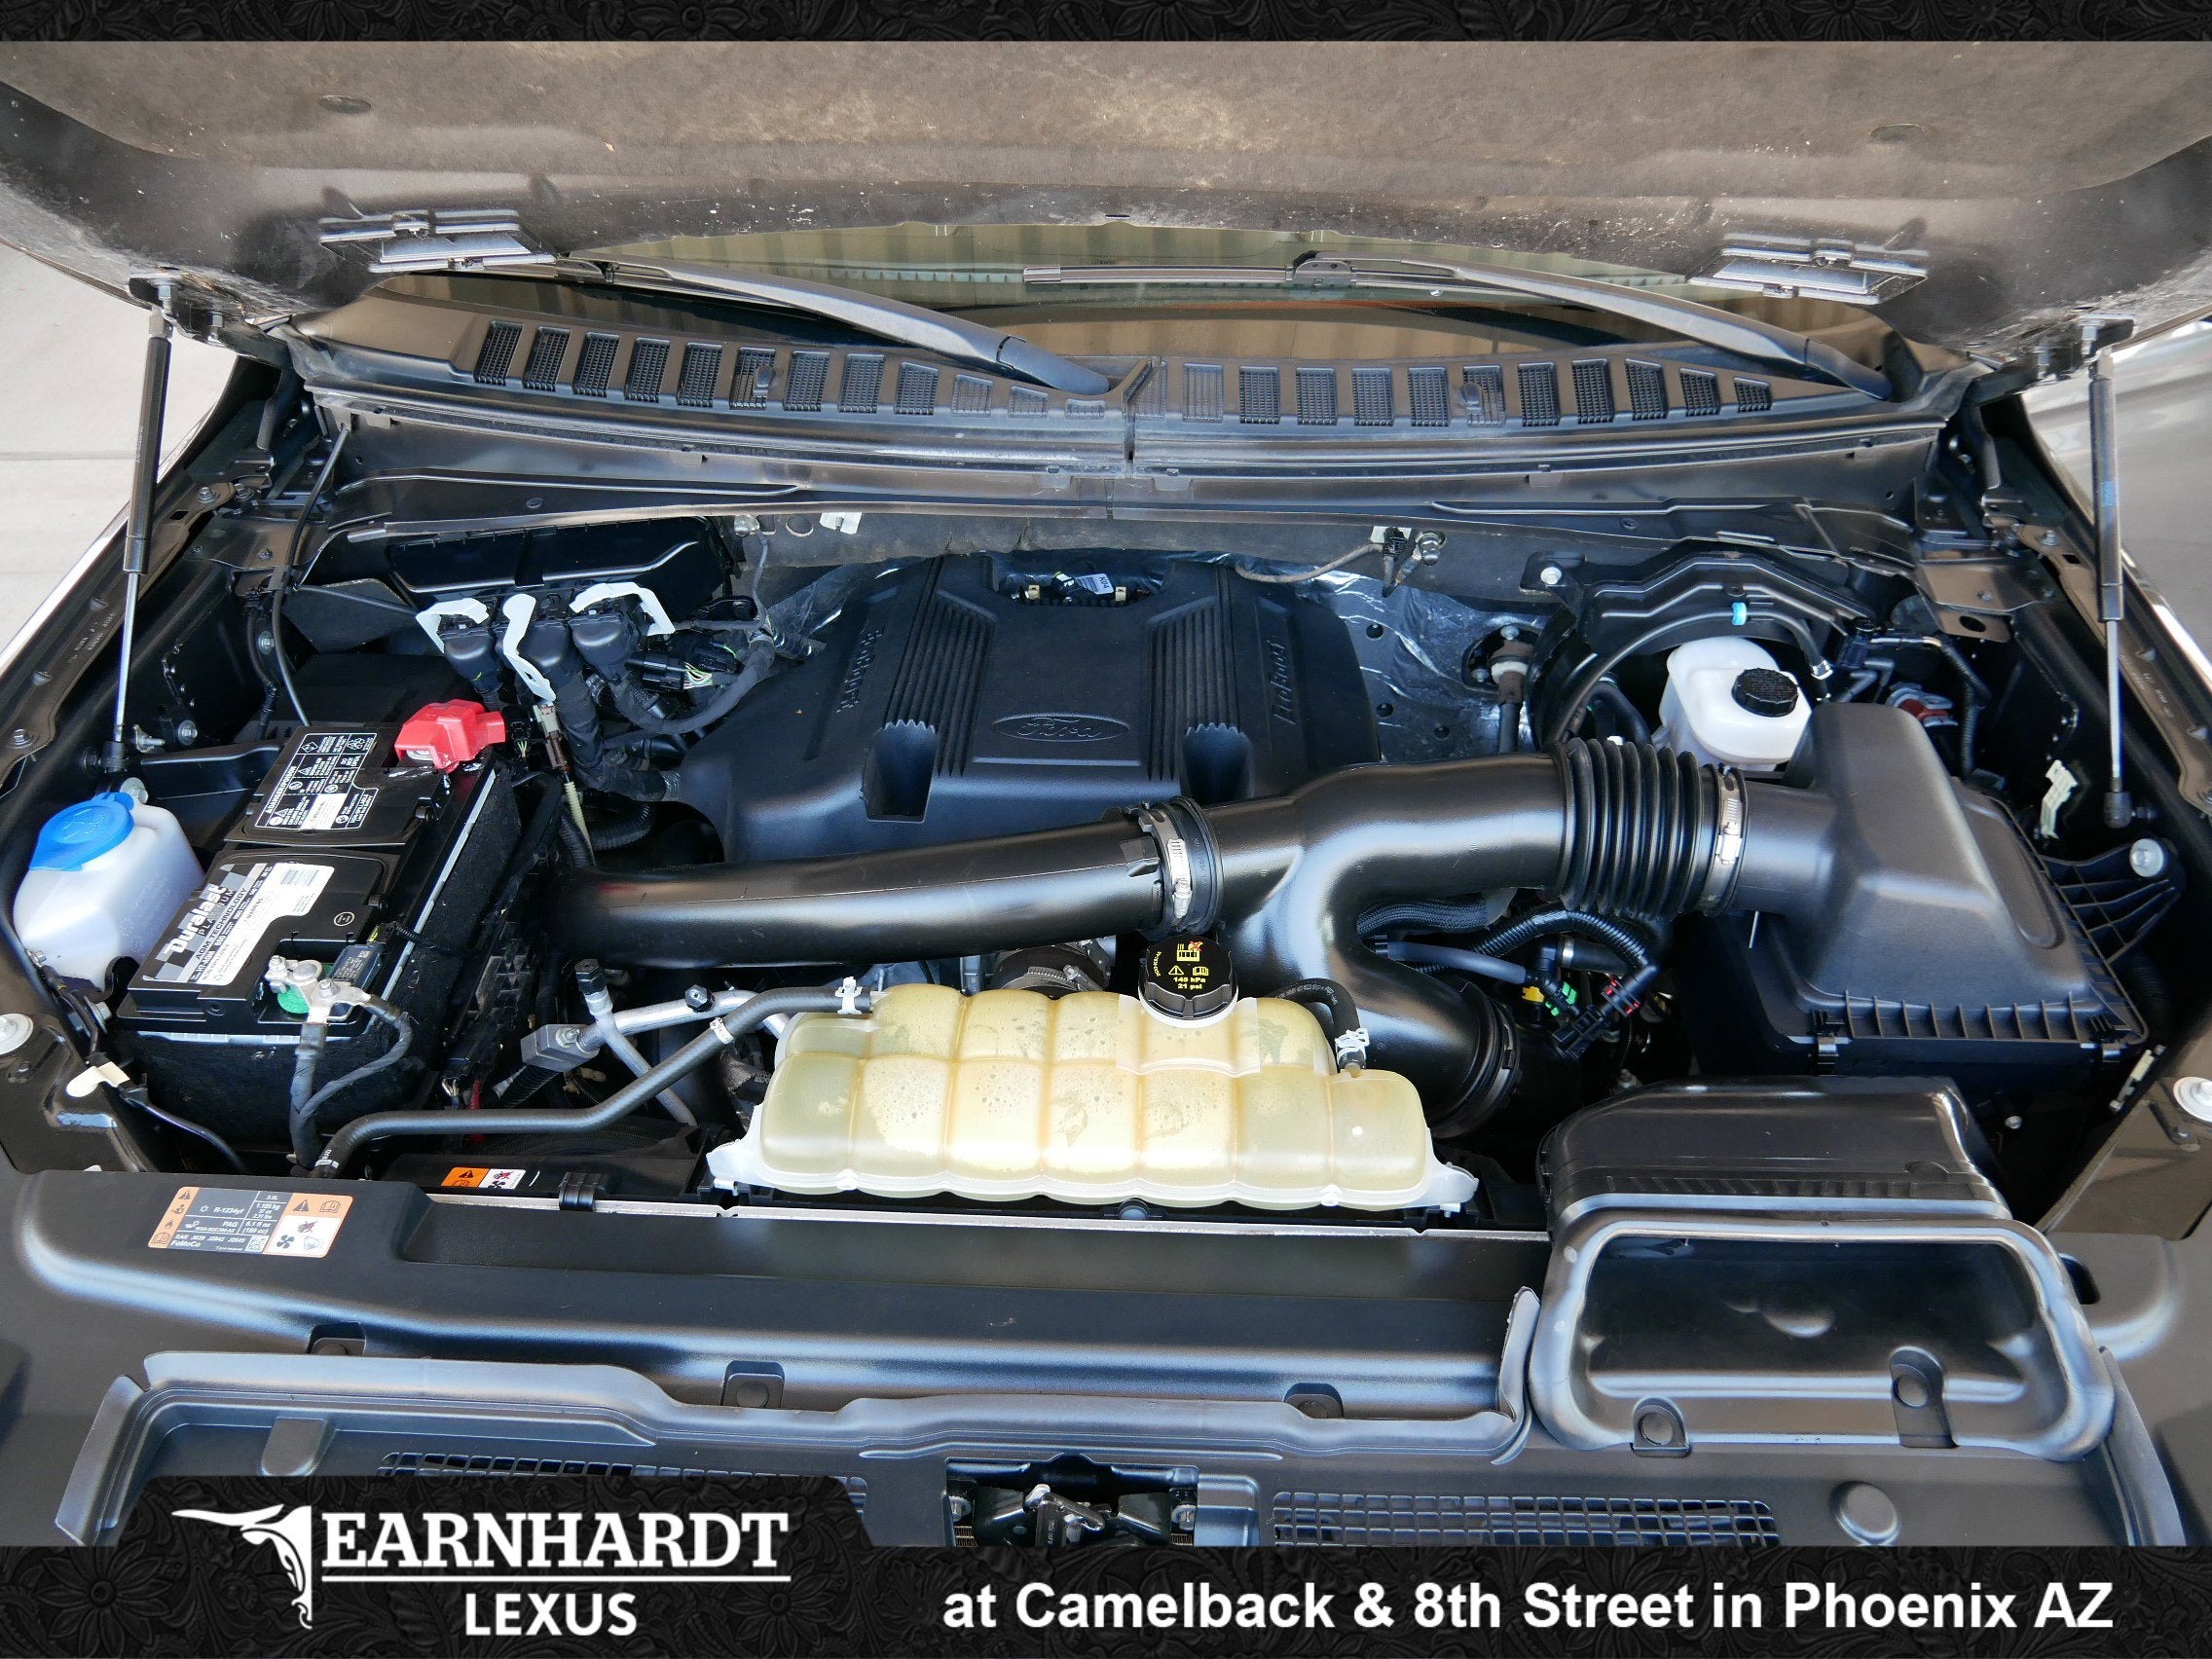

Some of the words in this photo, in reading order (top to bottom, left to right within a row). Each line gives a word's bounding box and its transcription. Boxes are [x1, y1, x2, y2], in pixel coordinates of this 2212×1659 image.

[164, 883, 227, 953] Duralast
[196, 940, 211, 960] AGM
[209, 888, 247, 940] TECHNOLOGY
